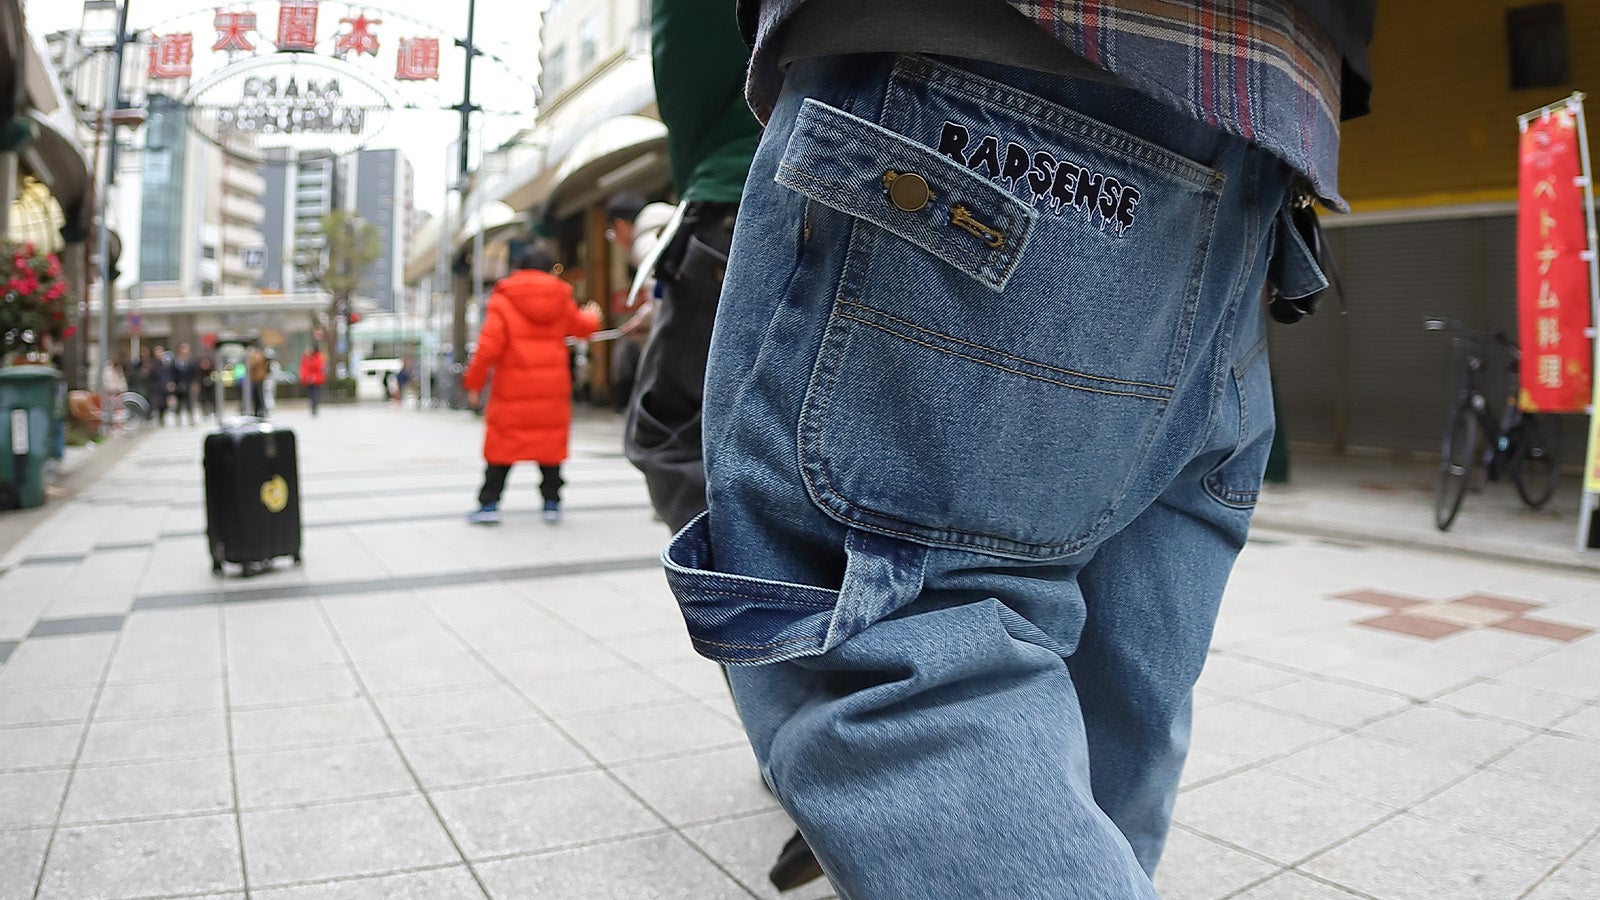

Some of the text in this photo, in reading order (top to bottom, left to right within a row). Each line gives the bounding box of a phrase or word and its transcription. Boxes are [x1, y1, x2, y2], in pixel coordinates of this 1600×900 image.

[937, 121, 1140, 237] RADSENSE
[1533, 175, 1563, 388] ベトナム料理
